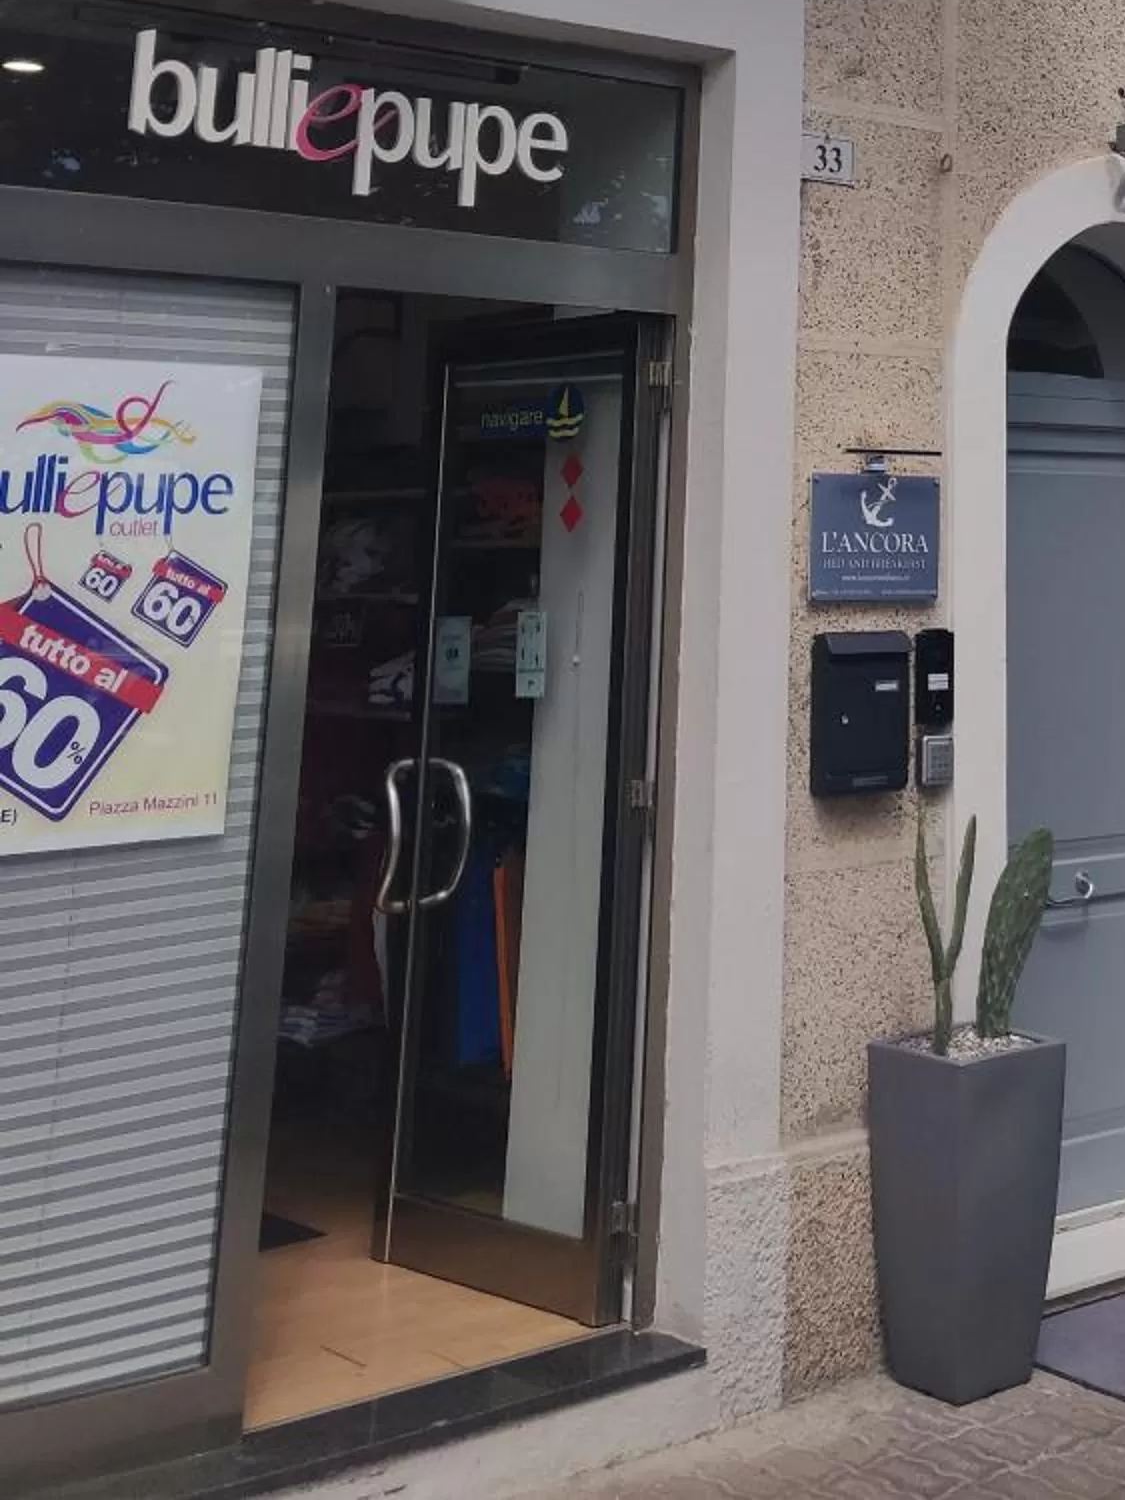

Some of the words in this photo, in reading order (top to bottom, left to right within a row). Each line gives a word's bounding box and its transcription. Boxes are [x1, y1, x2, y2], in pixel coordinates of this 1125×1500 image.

[813, 145, 842, 173] 33
[481, 411, 543, 431] navigare
[0, 454, 234, 536] ulliepupe
[109, 519, 160, 537] outlet
[822, 531, 929, 553] L'ANCORA
[85, 567, 119, 597] 60
[19, 623, 91, 677] tutto
[94, 665, 128, 694] al
[89, 798, 139, 817] Piazza
[143, 794, 199, 812] Mazzini
[204, 791, 218, 806] 11
